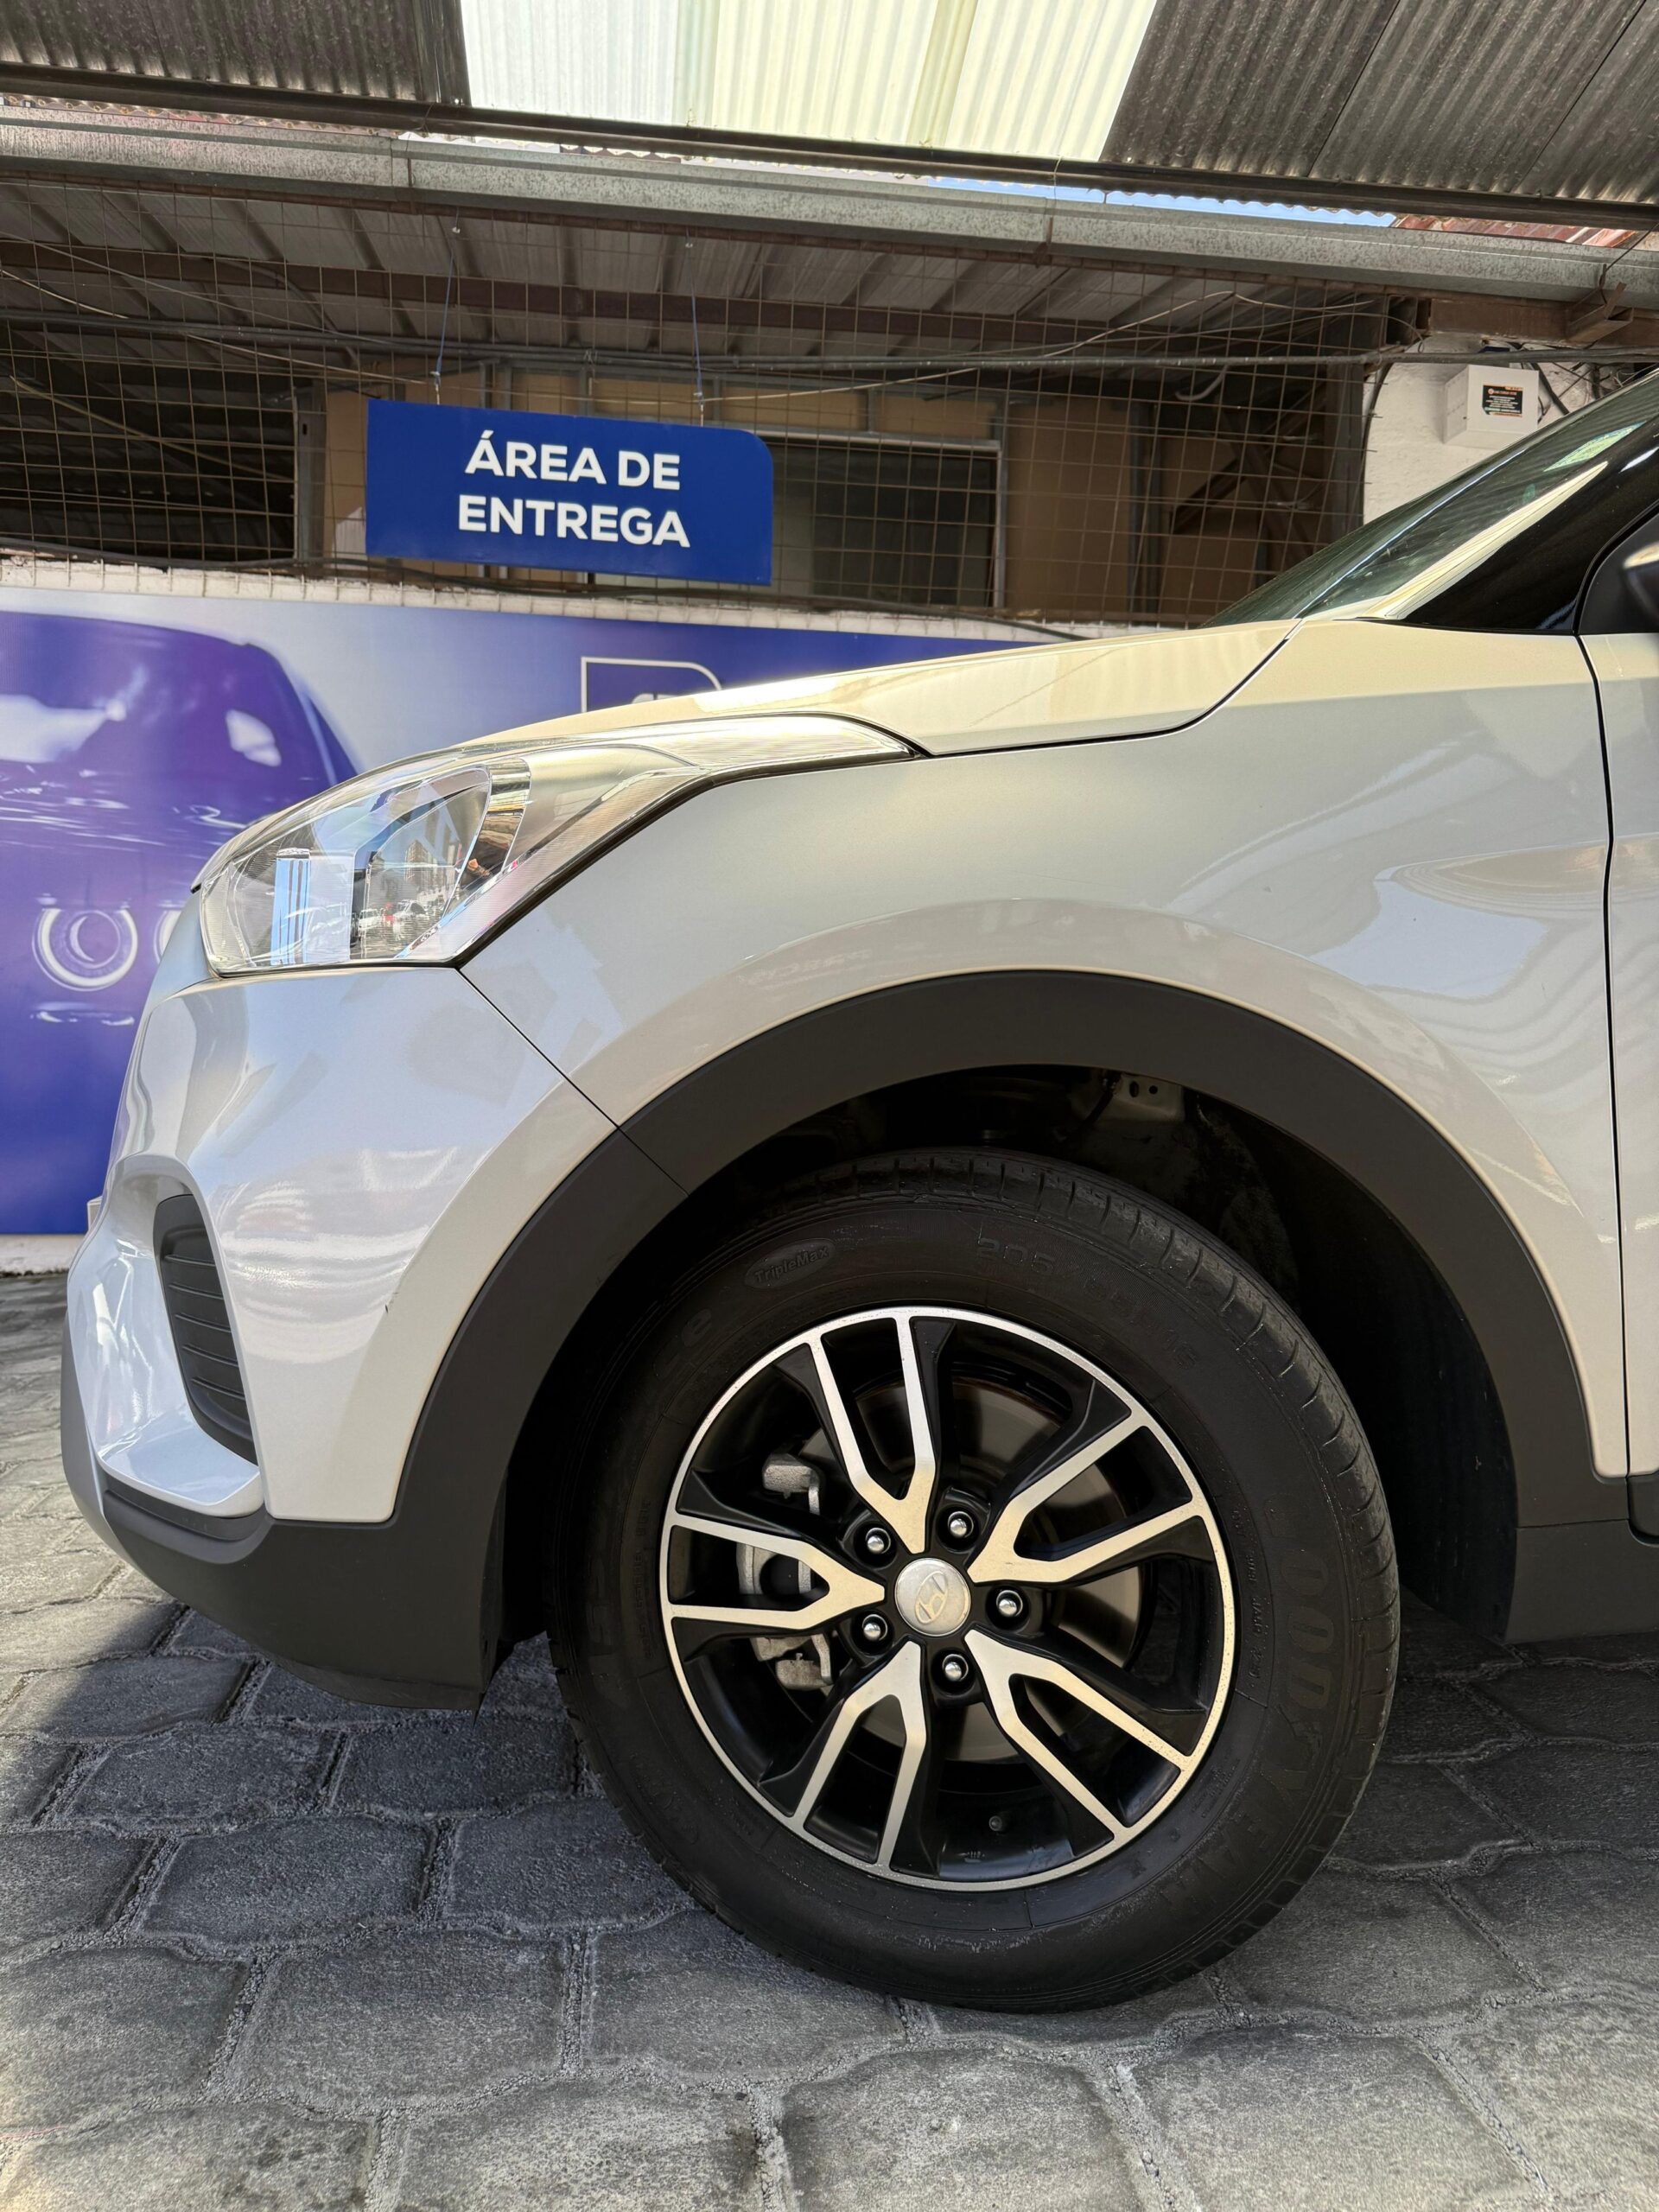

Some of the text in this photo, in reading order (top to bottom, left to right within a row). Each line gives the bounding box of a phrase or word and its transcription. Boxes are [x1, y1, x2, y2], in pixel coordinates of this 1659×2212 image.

[464, 429, 680, 490] ÁREA DE
[459, 494, 690, 548] ENTREGA
[754, 1245, 830, 1284] TripleMax
